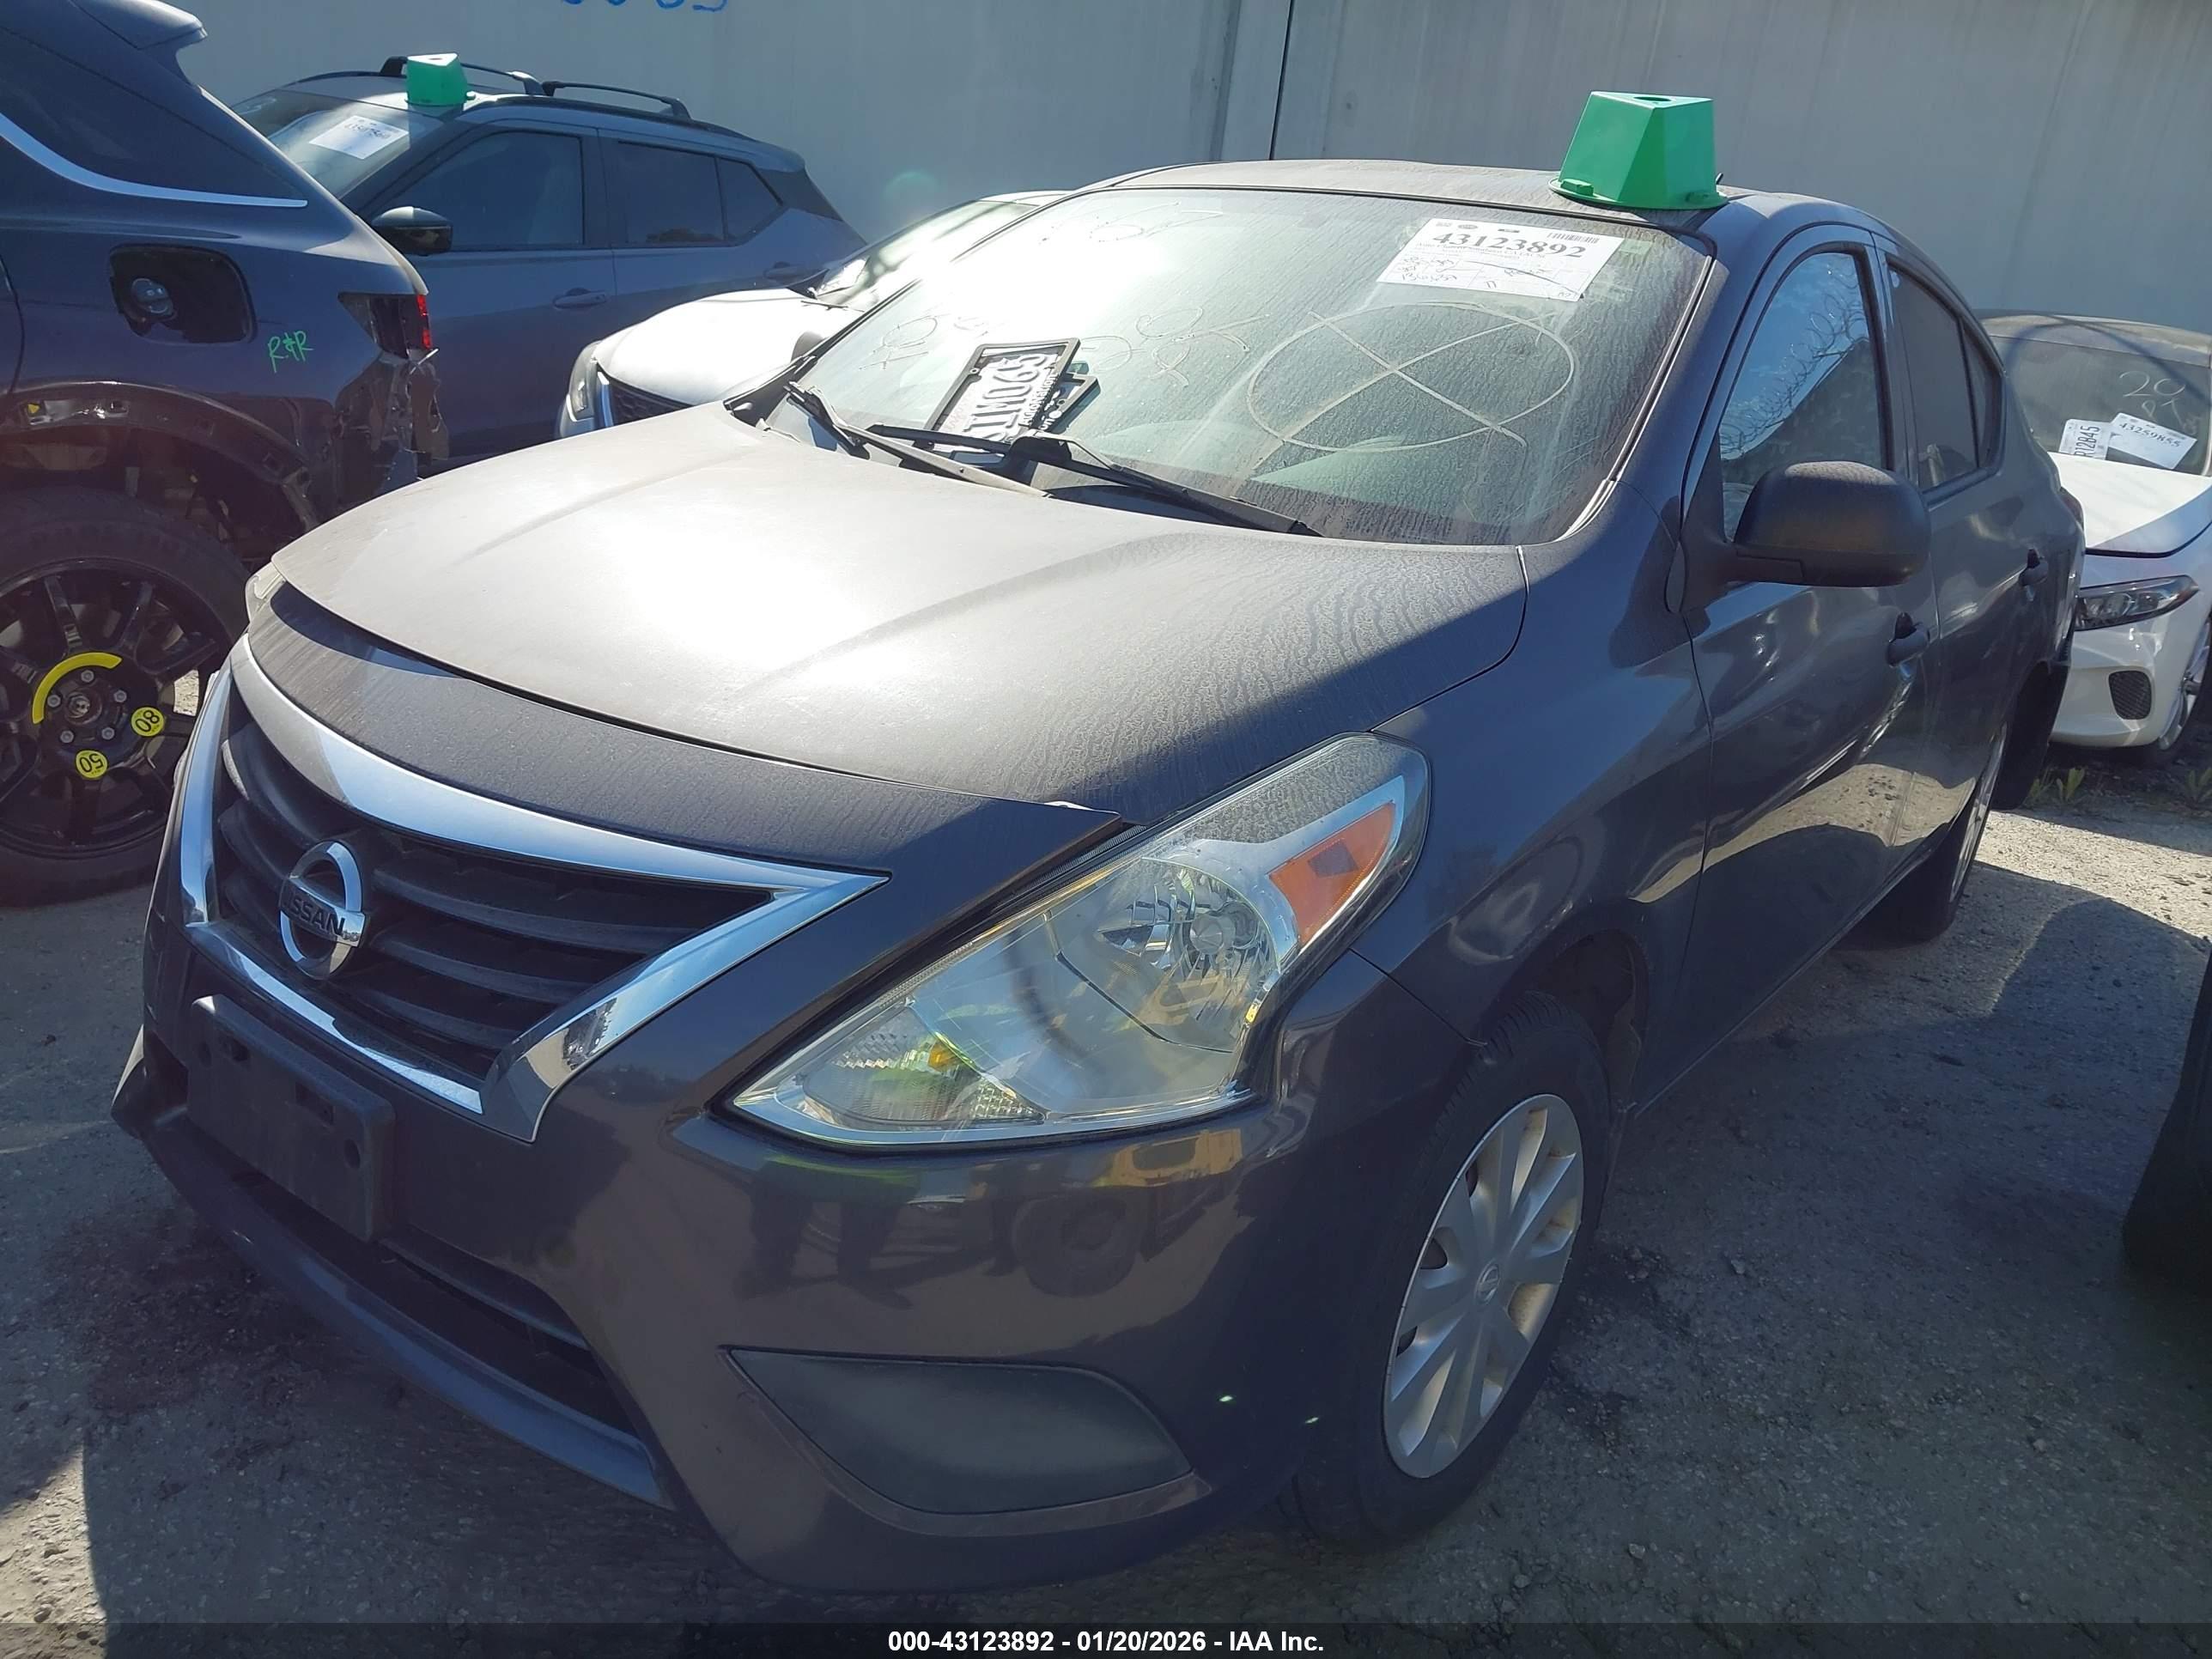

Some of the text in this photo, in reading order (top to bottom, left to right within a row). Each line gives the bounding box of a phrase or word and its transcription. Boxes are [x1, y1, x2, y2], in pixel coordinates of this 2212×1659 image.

[1432, 233, 1586, 258] 43123892
[135, 710, 161, 732] 80
[79, 753, 104, 774] 50
